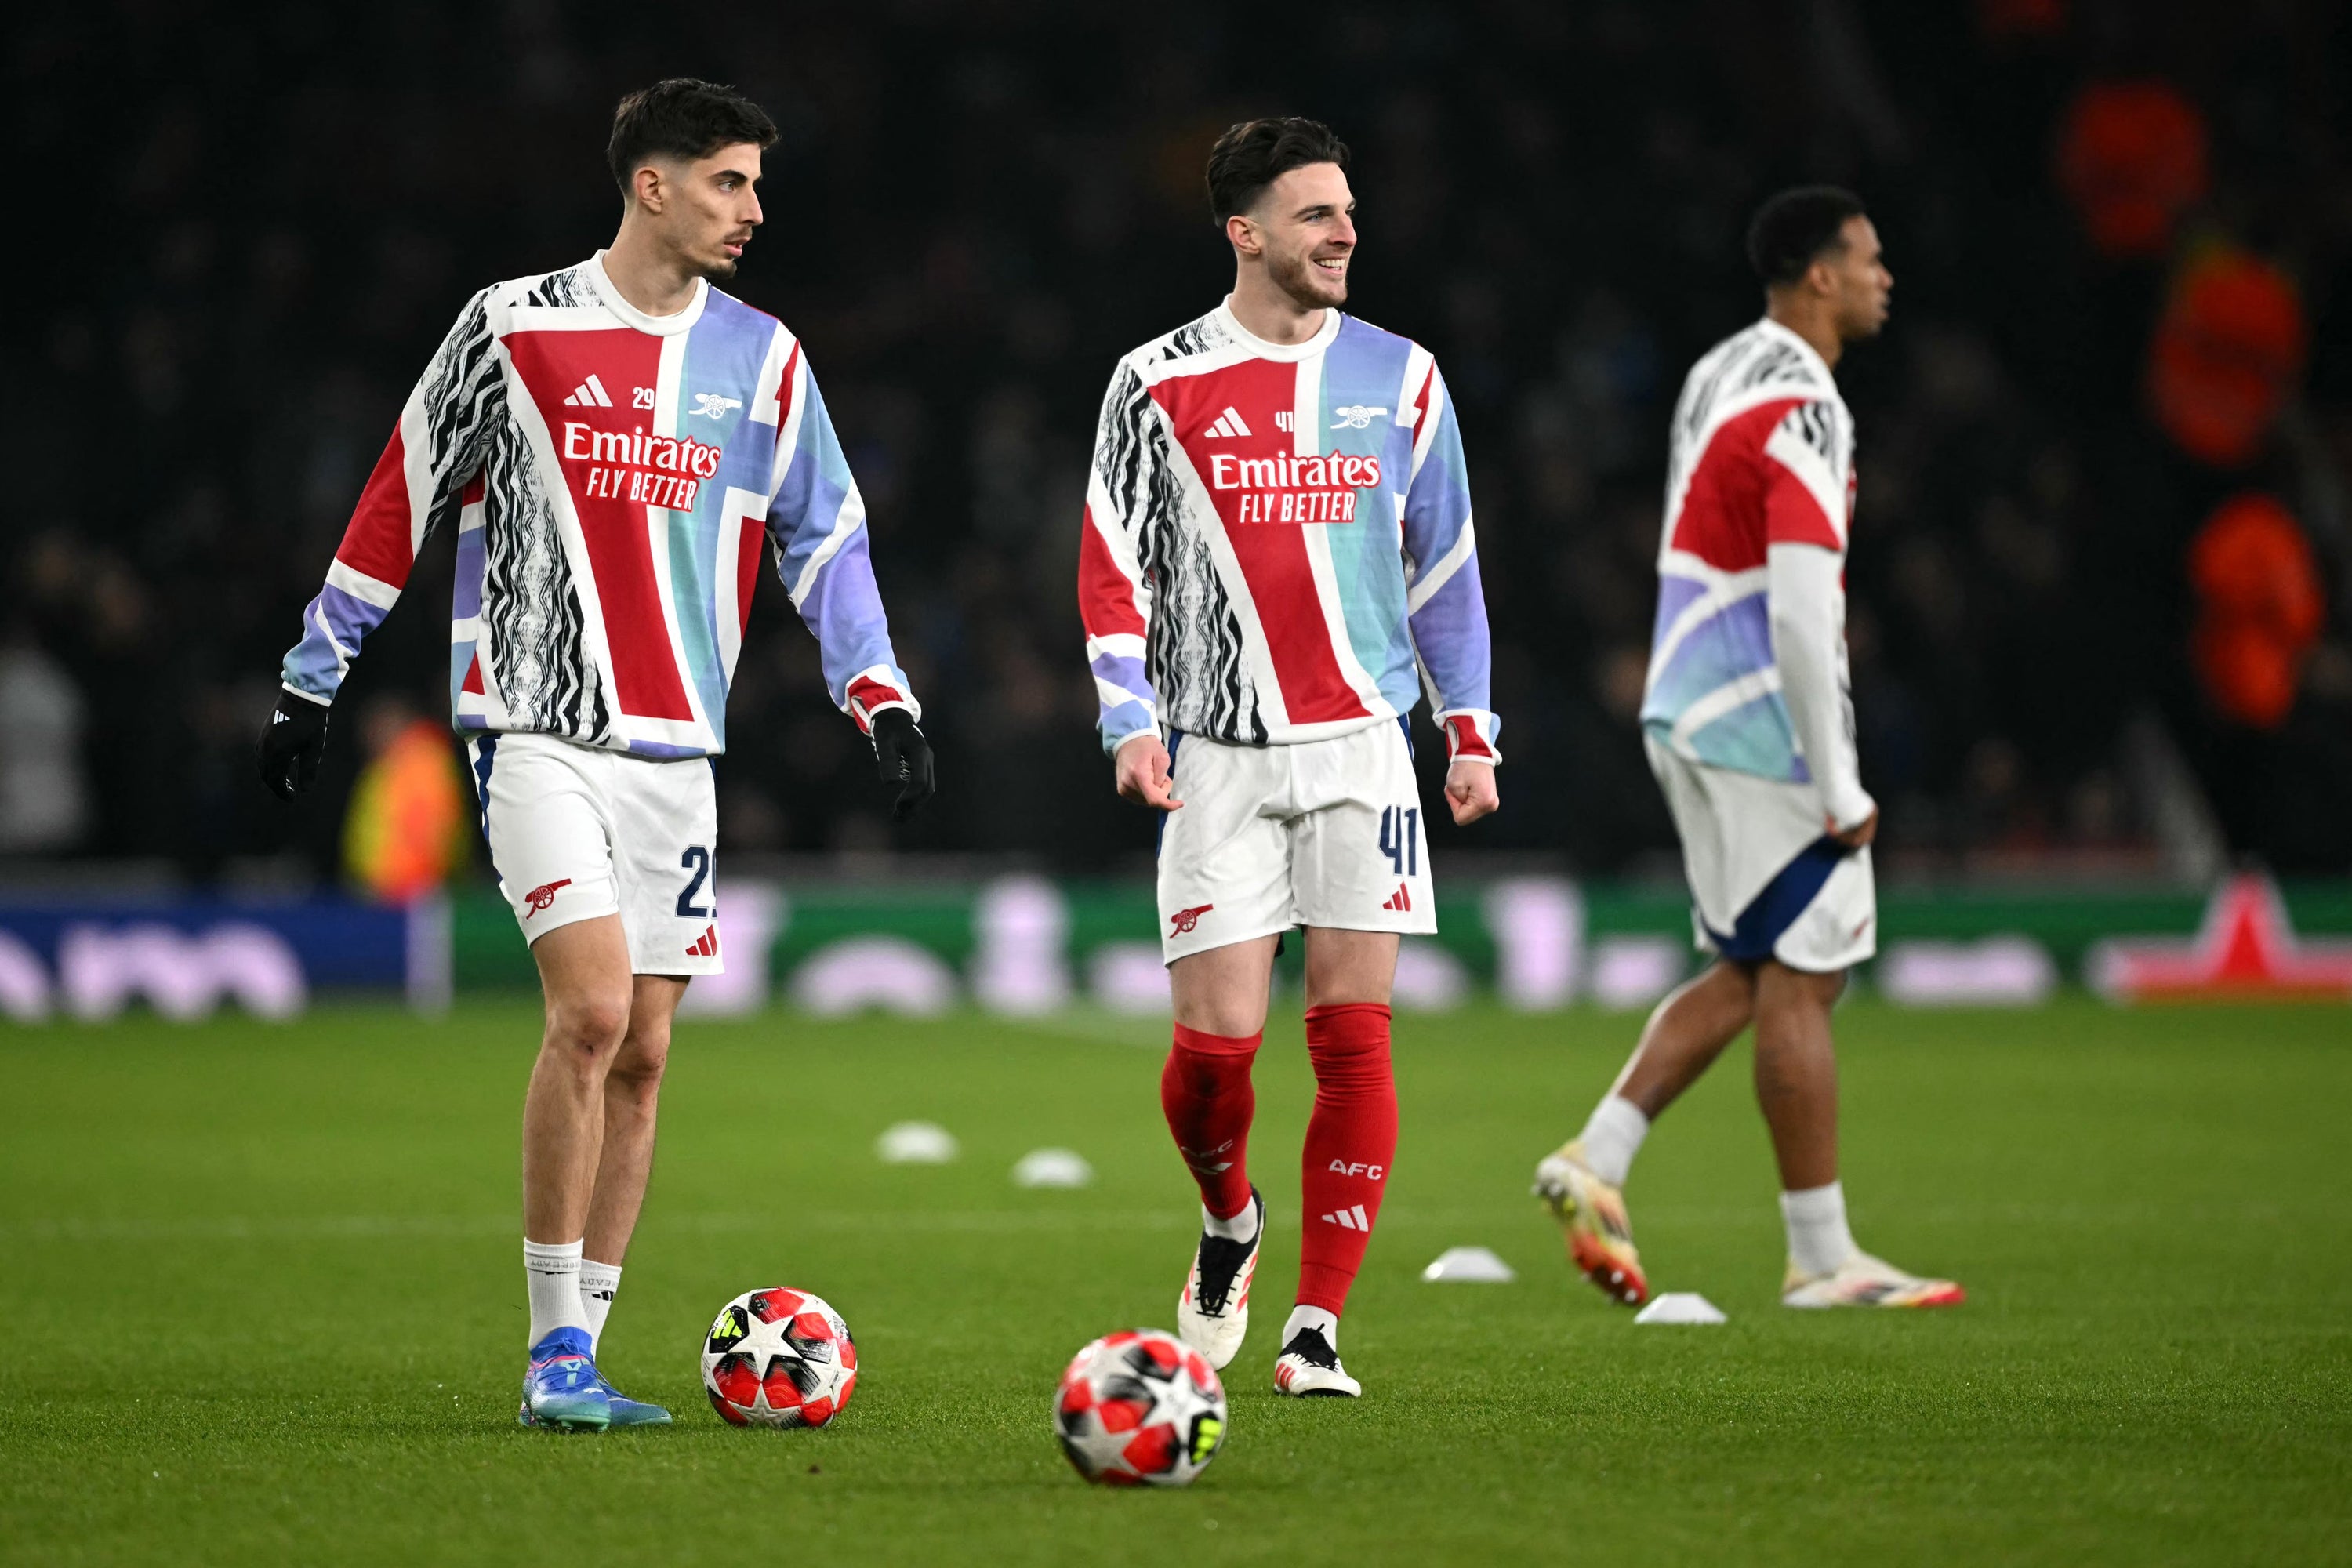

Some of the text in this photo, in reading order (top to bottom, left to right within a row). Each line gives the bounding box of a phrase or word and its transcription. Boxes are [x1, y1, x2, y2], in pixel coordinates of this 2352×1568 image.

[632, 386, 655, 410] 29
[1275, 411, 1294, 432] 41
[564, 421, 720, 477] Emirates
[586, 467, 698, 510] FLY BETTER
[1210, 450, 1381, 490] Emirates
[1239, 492, 1356, 524] FLY BETTER
[1377, 804, 1418, 878] 41
[674, 844, 718, 919] 2
[1329, 1158, 1383, 1181] AFC
